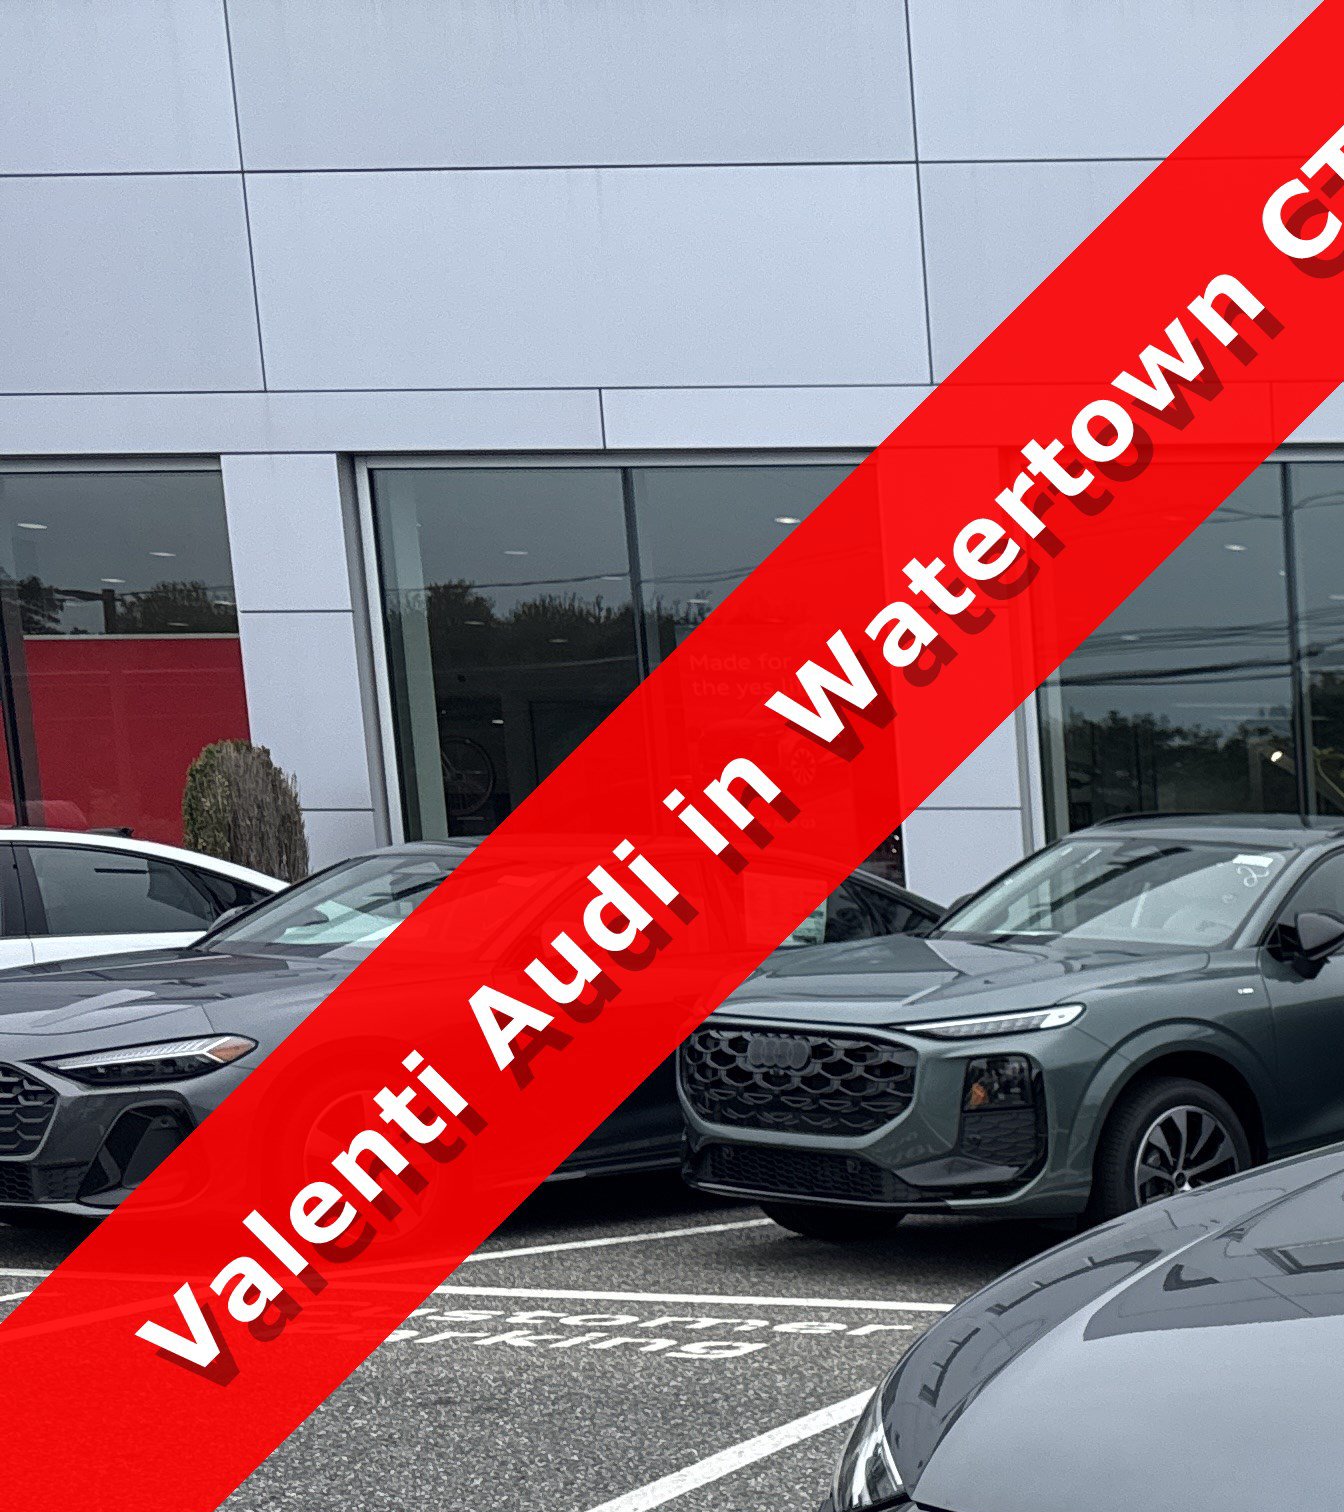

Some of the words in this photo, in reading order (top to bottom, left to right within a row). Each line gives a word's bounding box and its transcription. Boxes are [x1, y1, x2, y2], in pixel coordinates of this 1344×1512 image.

[688, 653, 752, 672] Made
[757, 652, 792, 671] for
[691, 678, 731, 697] the
